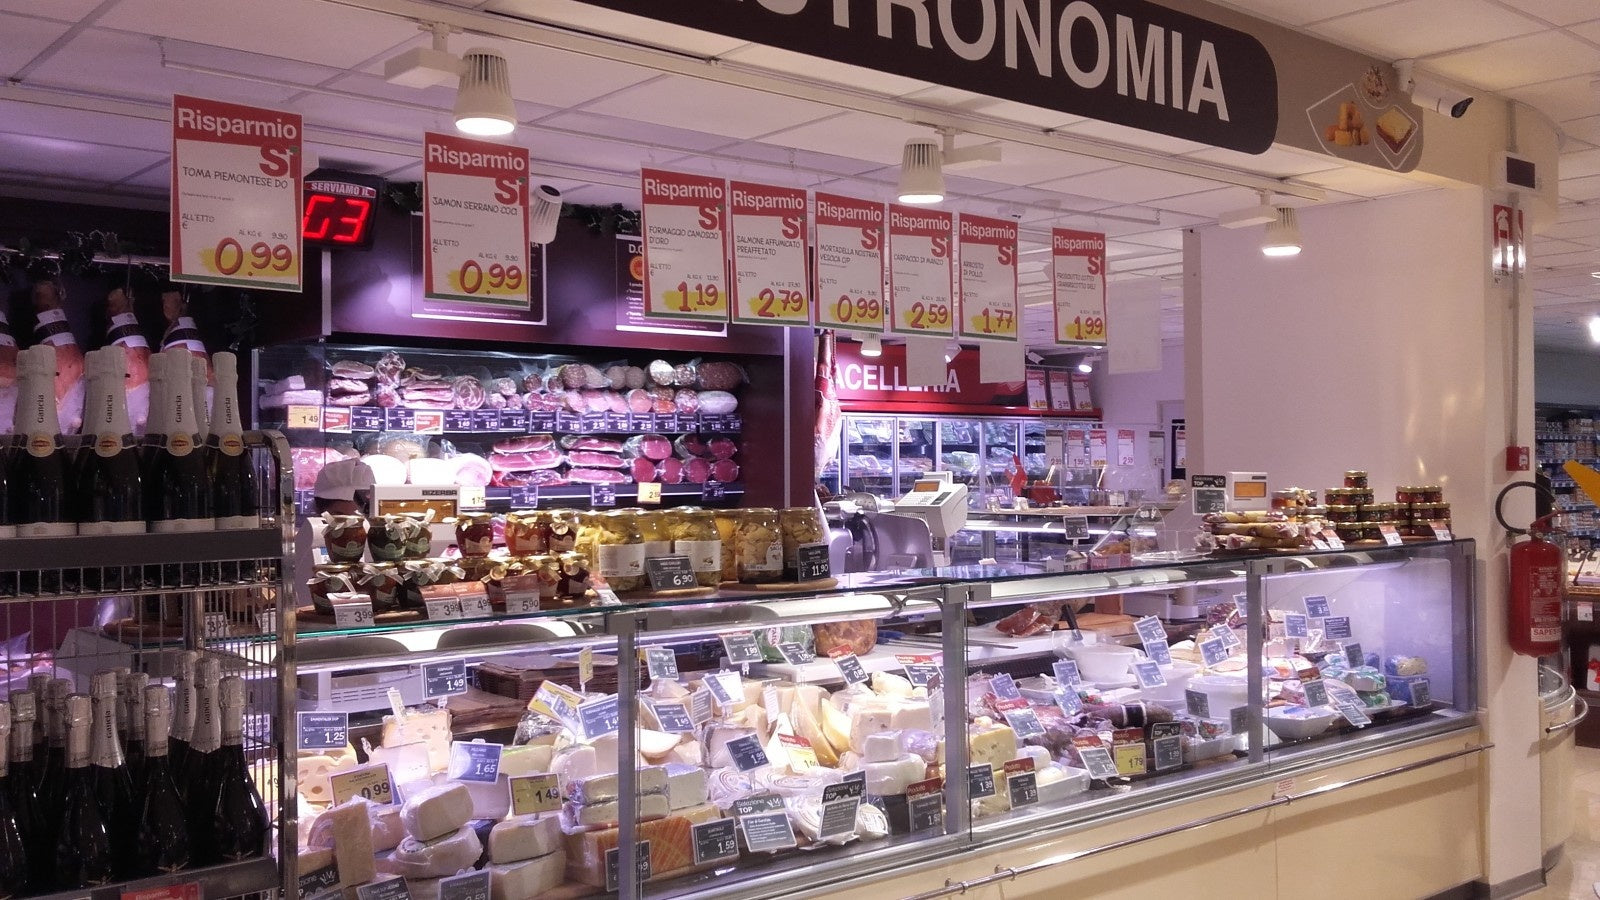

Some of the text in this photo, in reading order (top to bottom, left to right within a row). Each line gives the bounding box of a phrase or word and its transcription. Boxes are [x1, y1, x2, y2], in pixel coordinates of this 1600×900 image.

[757, 0, 1224, 122] RONOMIA
[178, 108, 297, 139] Risparmio
[428, 143, 526, 171] Risparmio
[182, 166, 289, 190] TOMA PIEMONTESE DO
[311, 183, 359, 196] SERVIAMO
[644, 178, 723, 201] Risparmio
[732, 190, 804, 211] Risparmio
[432, 197, 461, 209] JAMON
[463, 202, 499, 214] SERRANO
[817, 200, 882, 222] Risparmio
[891, 211, 951, 232] Risparmio
[960, 221, 1016, 240] Risparmio
[649, 225, 719, 241] FORMAGGIO CAMOSCIO
[736, 235, 801, 250] SALMONE AFFUMICATO
[1053, 235, 1104, 253] Risparmio
[215, 237, 293, 276] 0.99
[736, 246, 777, 256] PREAFFETATO
[820, 245, 854, 256] MORTADELLA
[460, 259, 522, 295] 0.99
[677, 281, 719, 312] 1.19
[758, 288, 804, 318] 2.79
[837, 294, 881, 324] 0.99
[910, 301, 948, 329] 2.59
[981, 307, 1013, 333] 1.77
[1073, 316, 1104, 340] 1.99
[37, 394, 45, 424] Gancia
[105, 394, 113, 424] Gancia
[672, 574, 693, 587] 6.90
[447, 677, 465, 692] 1.49
[105, 709, 113, 739] Gancia
[324, 731, 346, 744] 1.25
[475, 764, 497, 776] 1.65
[738, 806, 753, 815] TOP
[717, 840, 735, 854] 1.59
